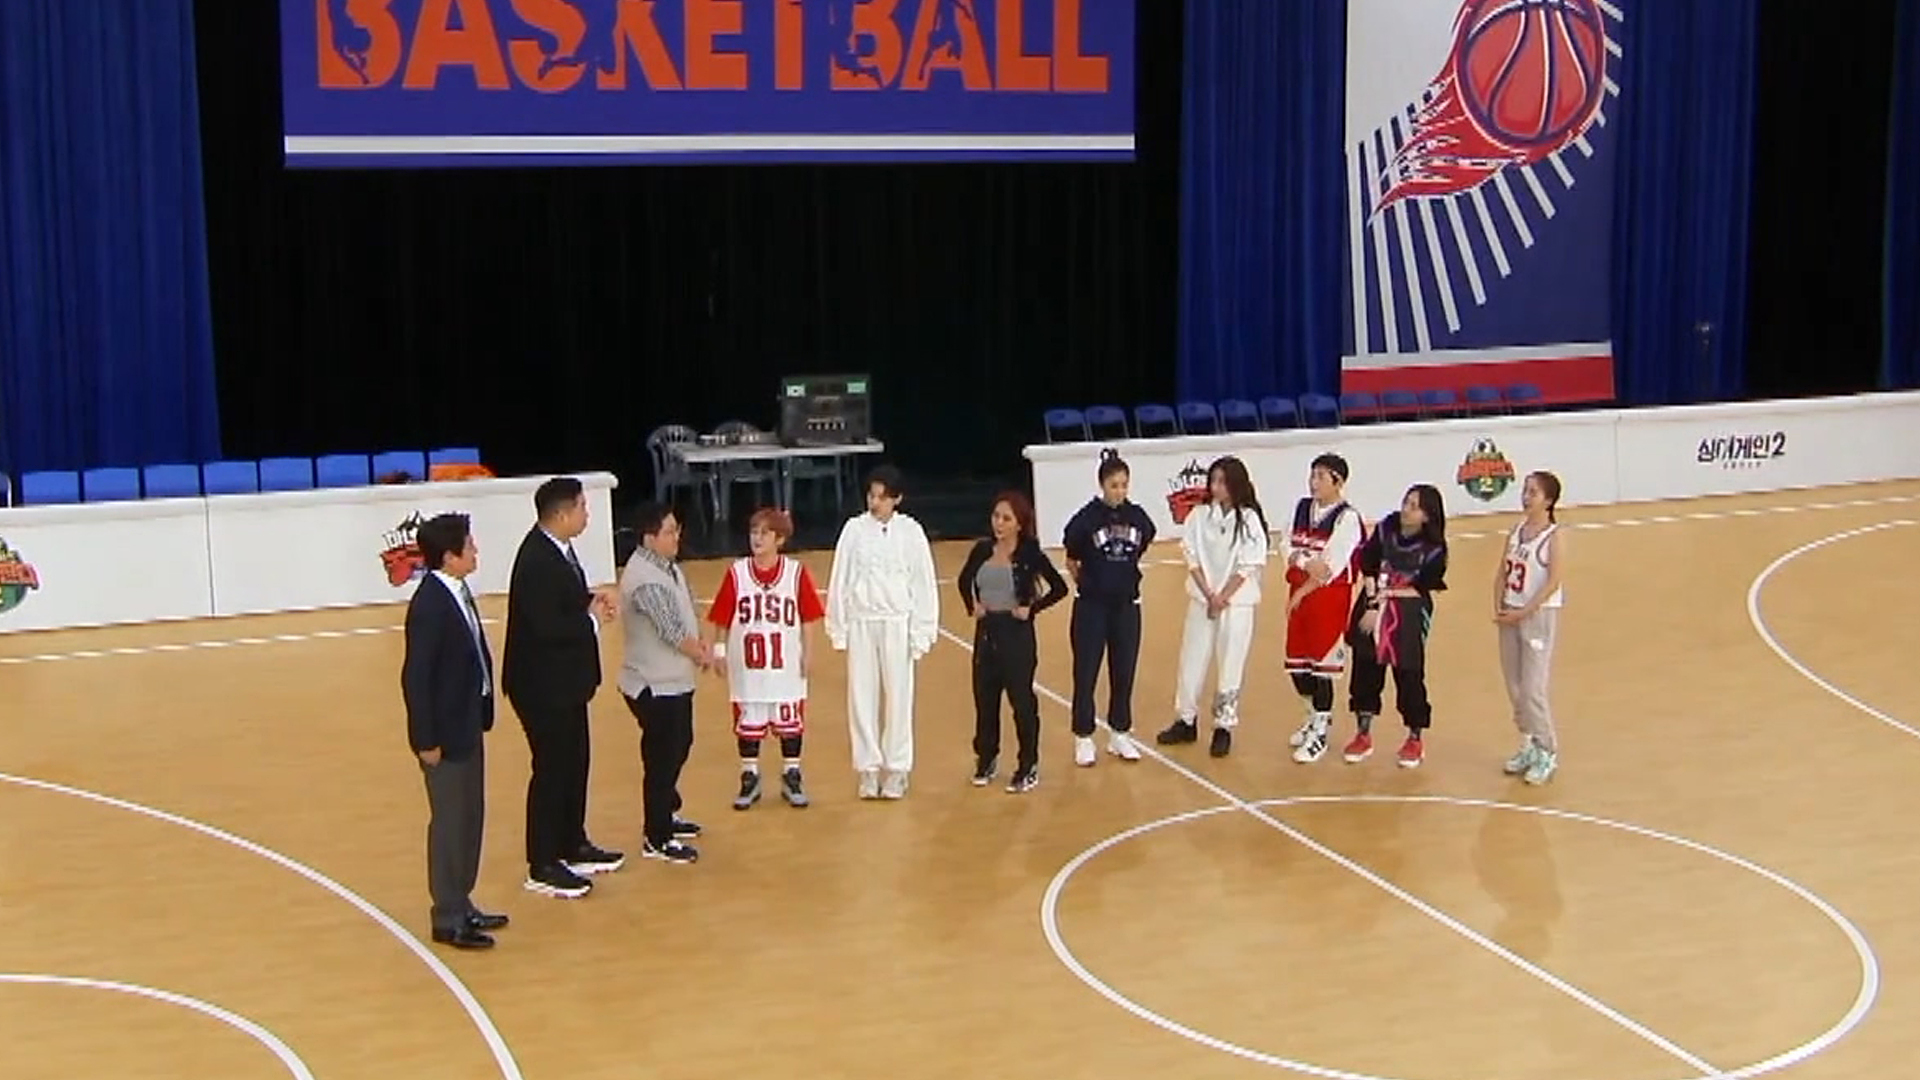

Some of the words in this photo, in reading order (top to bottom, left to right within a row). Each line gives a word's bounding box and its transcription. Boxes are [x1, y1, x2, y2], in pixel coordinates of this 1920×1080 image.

[316, 0, 1109, 93] BASKETBALL
[738, 592, 796, 627] SISO
[743, 632, 784, 670] 01
